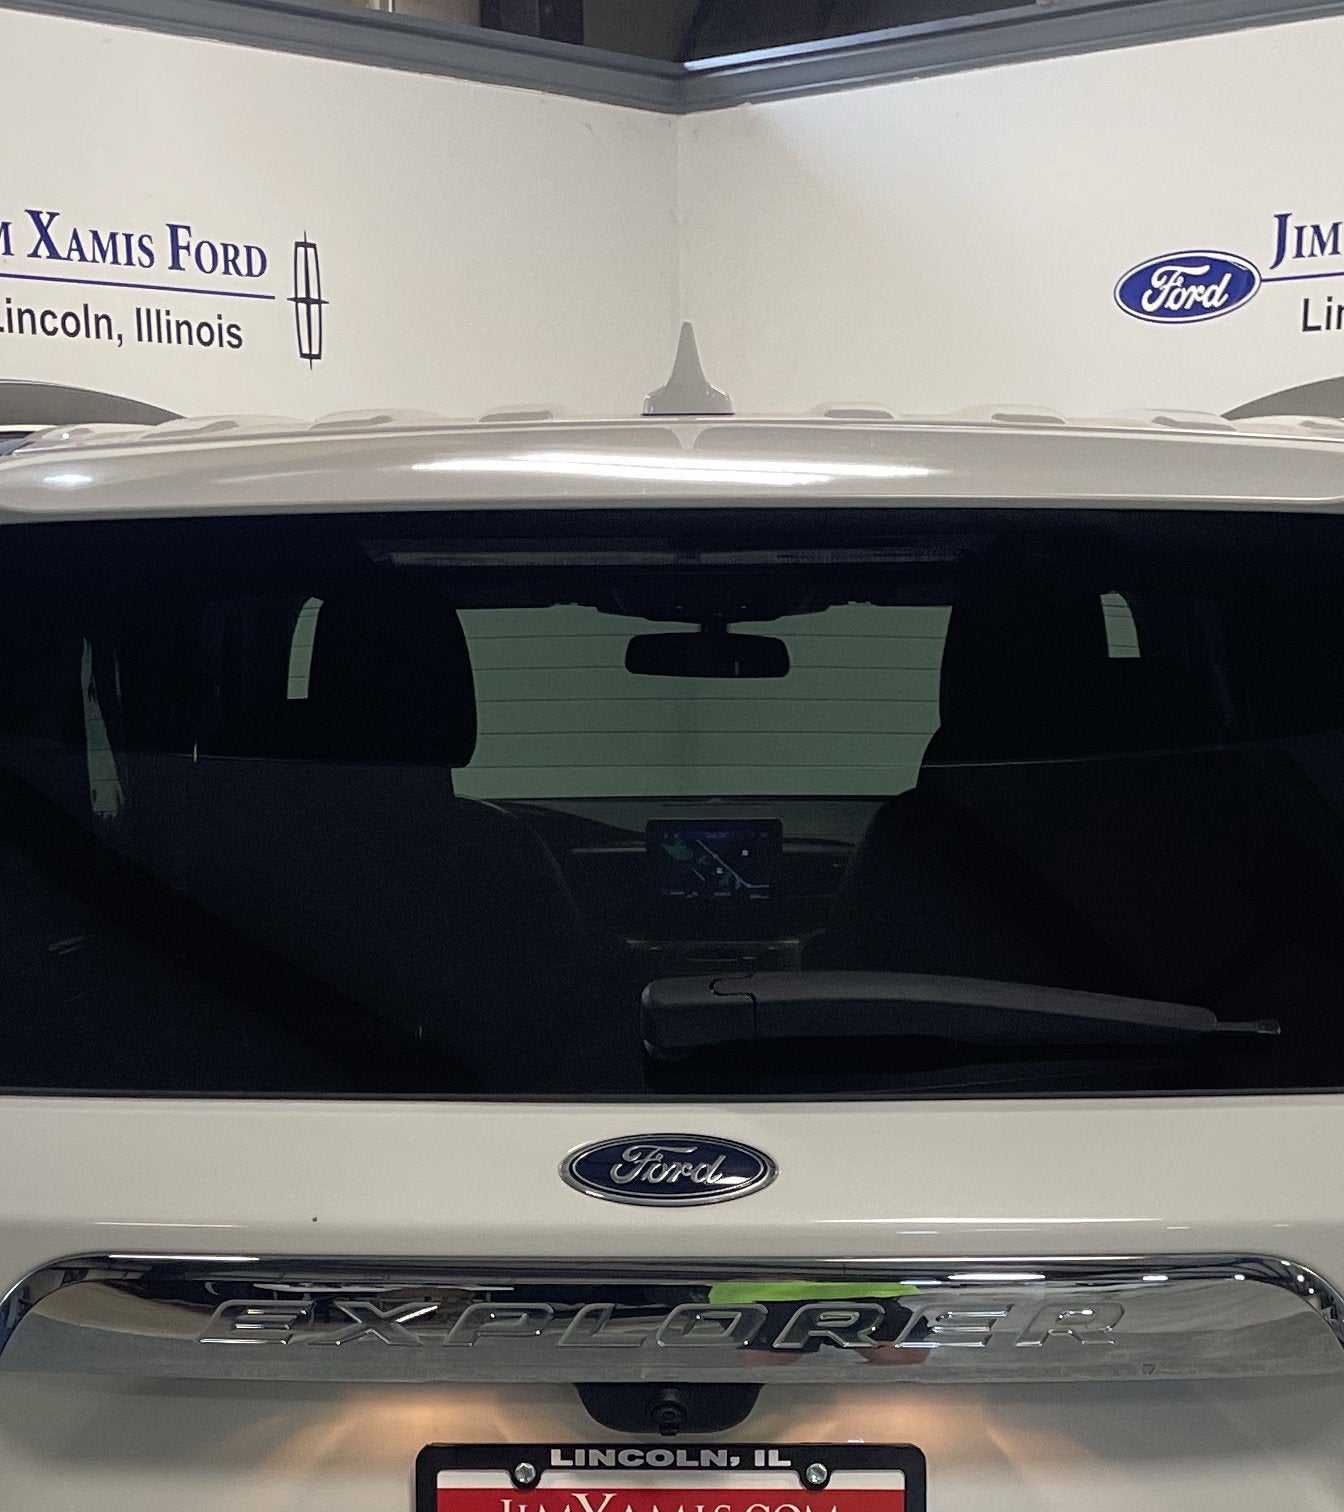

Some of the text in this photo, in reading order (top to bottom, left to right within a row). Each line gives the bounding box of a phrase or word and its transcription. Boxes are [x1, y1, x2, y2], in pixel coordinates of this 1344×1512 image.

[1141, 264, 1230, 312] Ford
[135, 307, 244, 350] Illinois
[609, 1144, 727, 1185] Ford
[197, 1300, 1127, 1348] EXPLORER
[551, 1449, 791, 1467] LINCOLN, IL
